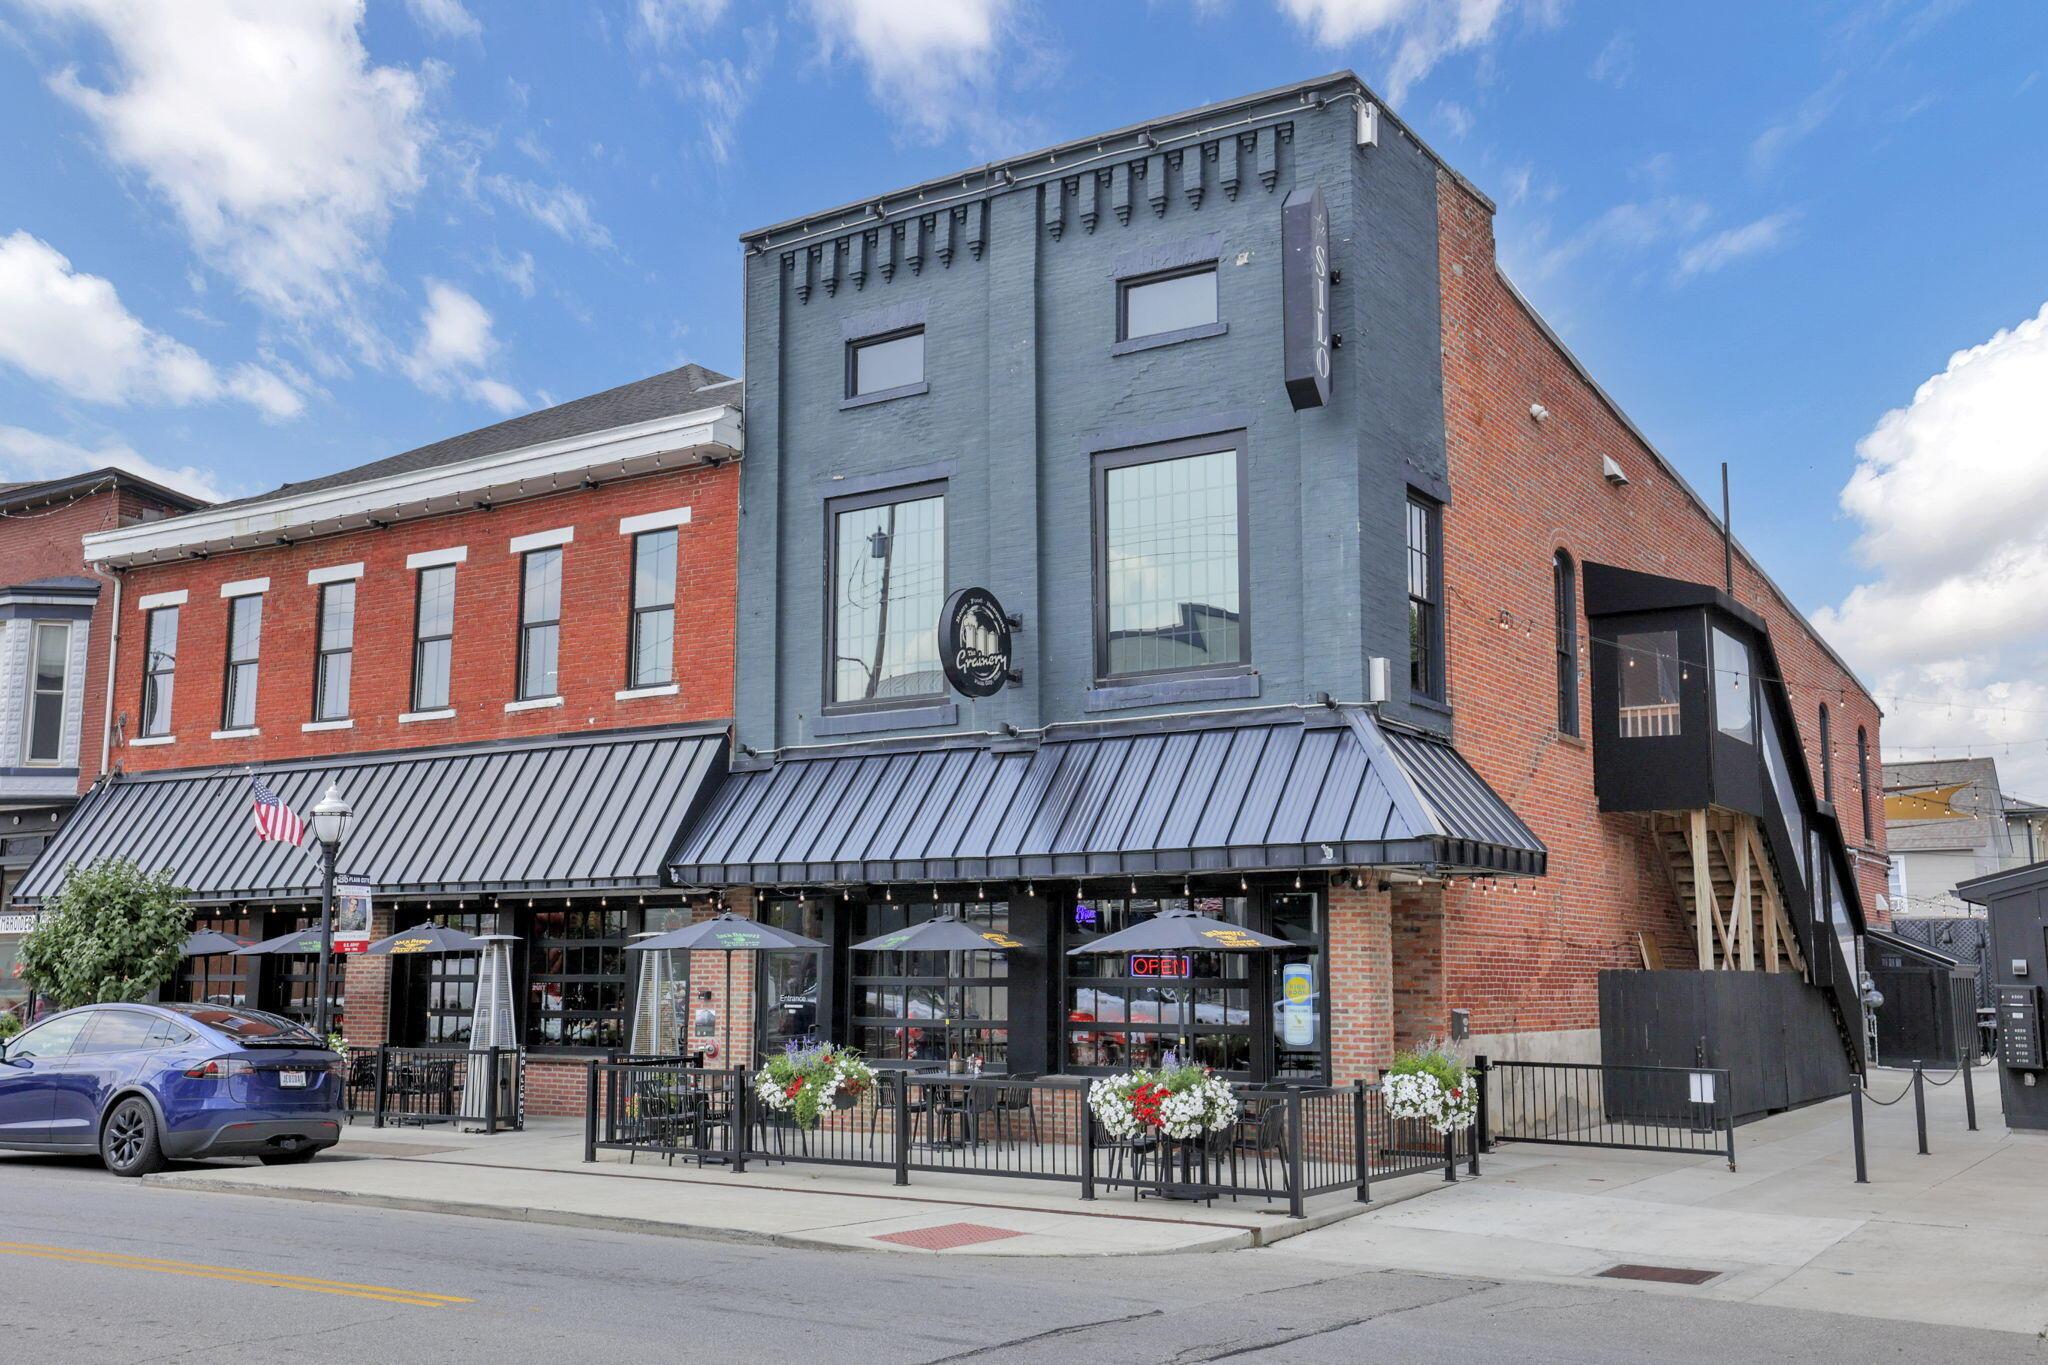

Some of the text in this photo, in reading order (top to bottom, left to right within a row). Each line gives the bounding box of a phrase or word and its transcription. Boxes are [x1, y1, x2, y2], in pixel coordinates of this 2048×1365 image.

[1314, 245, 1330, 379] SILO
[956, 649, 1007, 674] Grainery
[1133, 958, 1186, 975] OPEN
[779, 994, 807, 1003] Entrance
